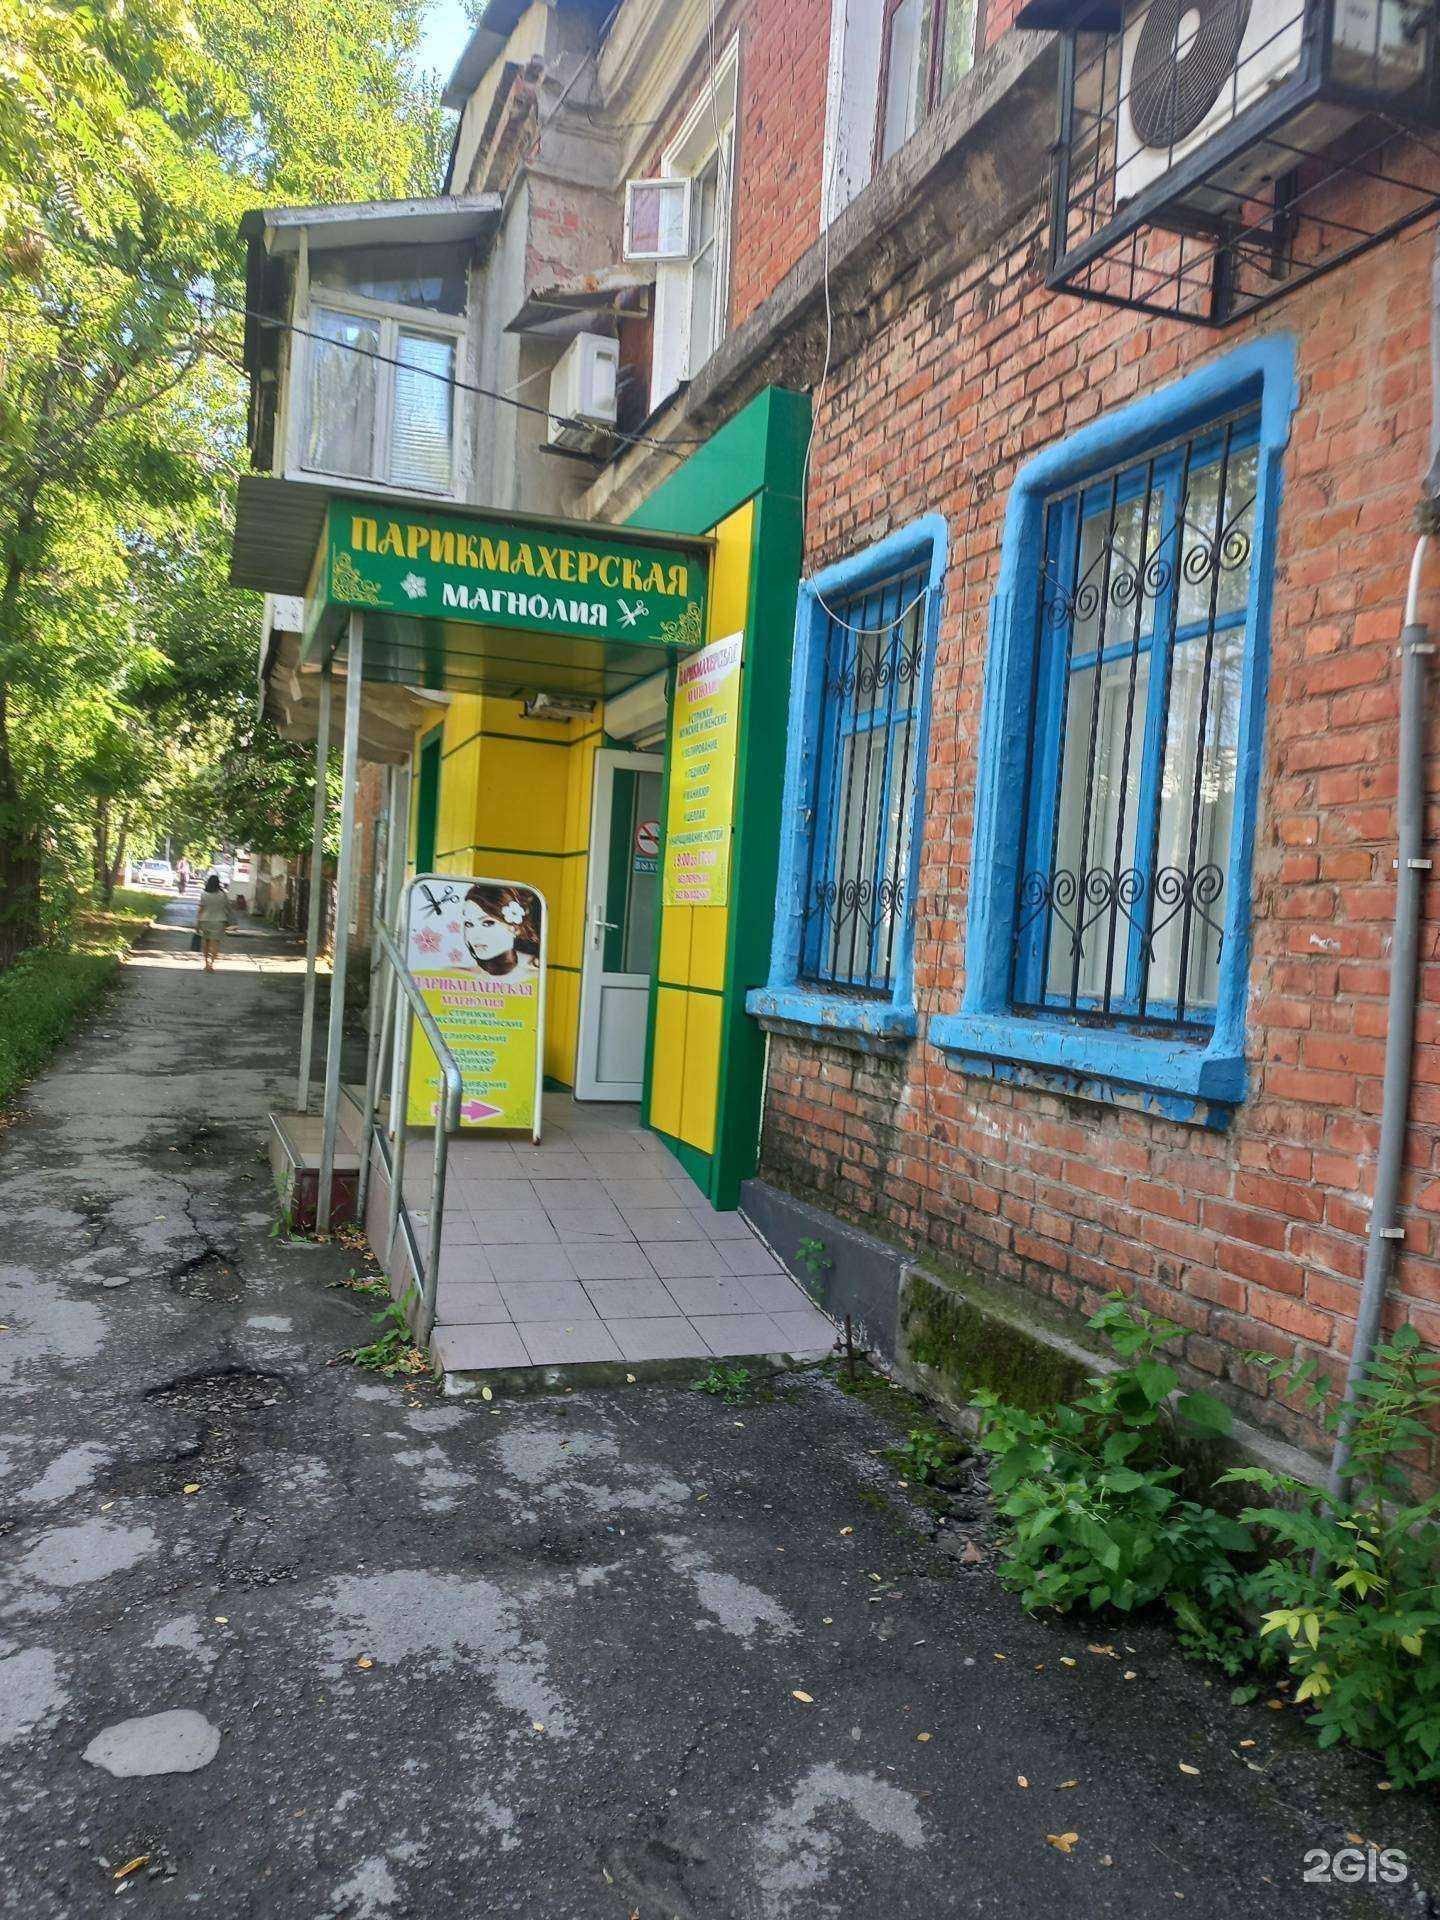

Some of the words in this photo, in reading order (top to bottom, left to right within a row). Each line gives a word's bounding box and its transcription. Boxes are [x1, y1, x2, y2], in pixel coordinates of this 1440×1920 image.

[352, 516, 689, 597] ПАРИКМАХЕРСКАЯ
[442, 582, 608, 627] МАГНОЛИЯ
[434, 1015, 467, 1025] ЖСКИЕ
[451, 1049, 495, 1057] ЕДИКЮР
[459, 1064, 491, 1072] ЕЛЛАК
